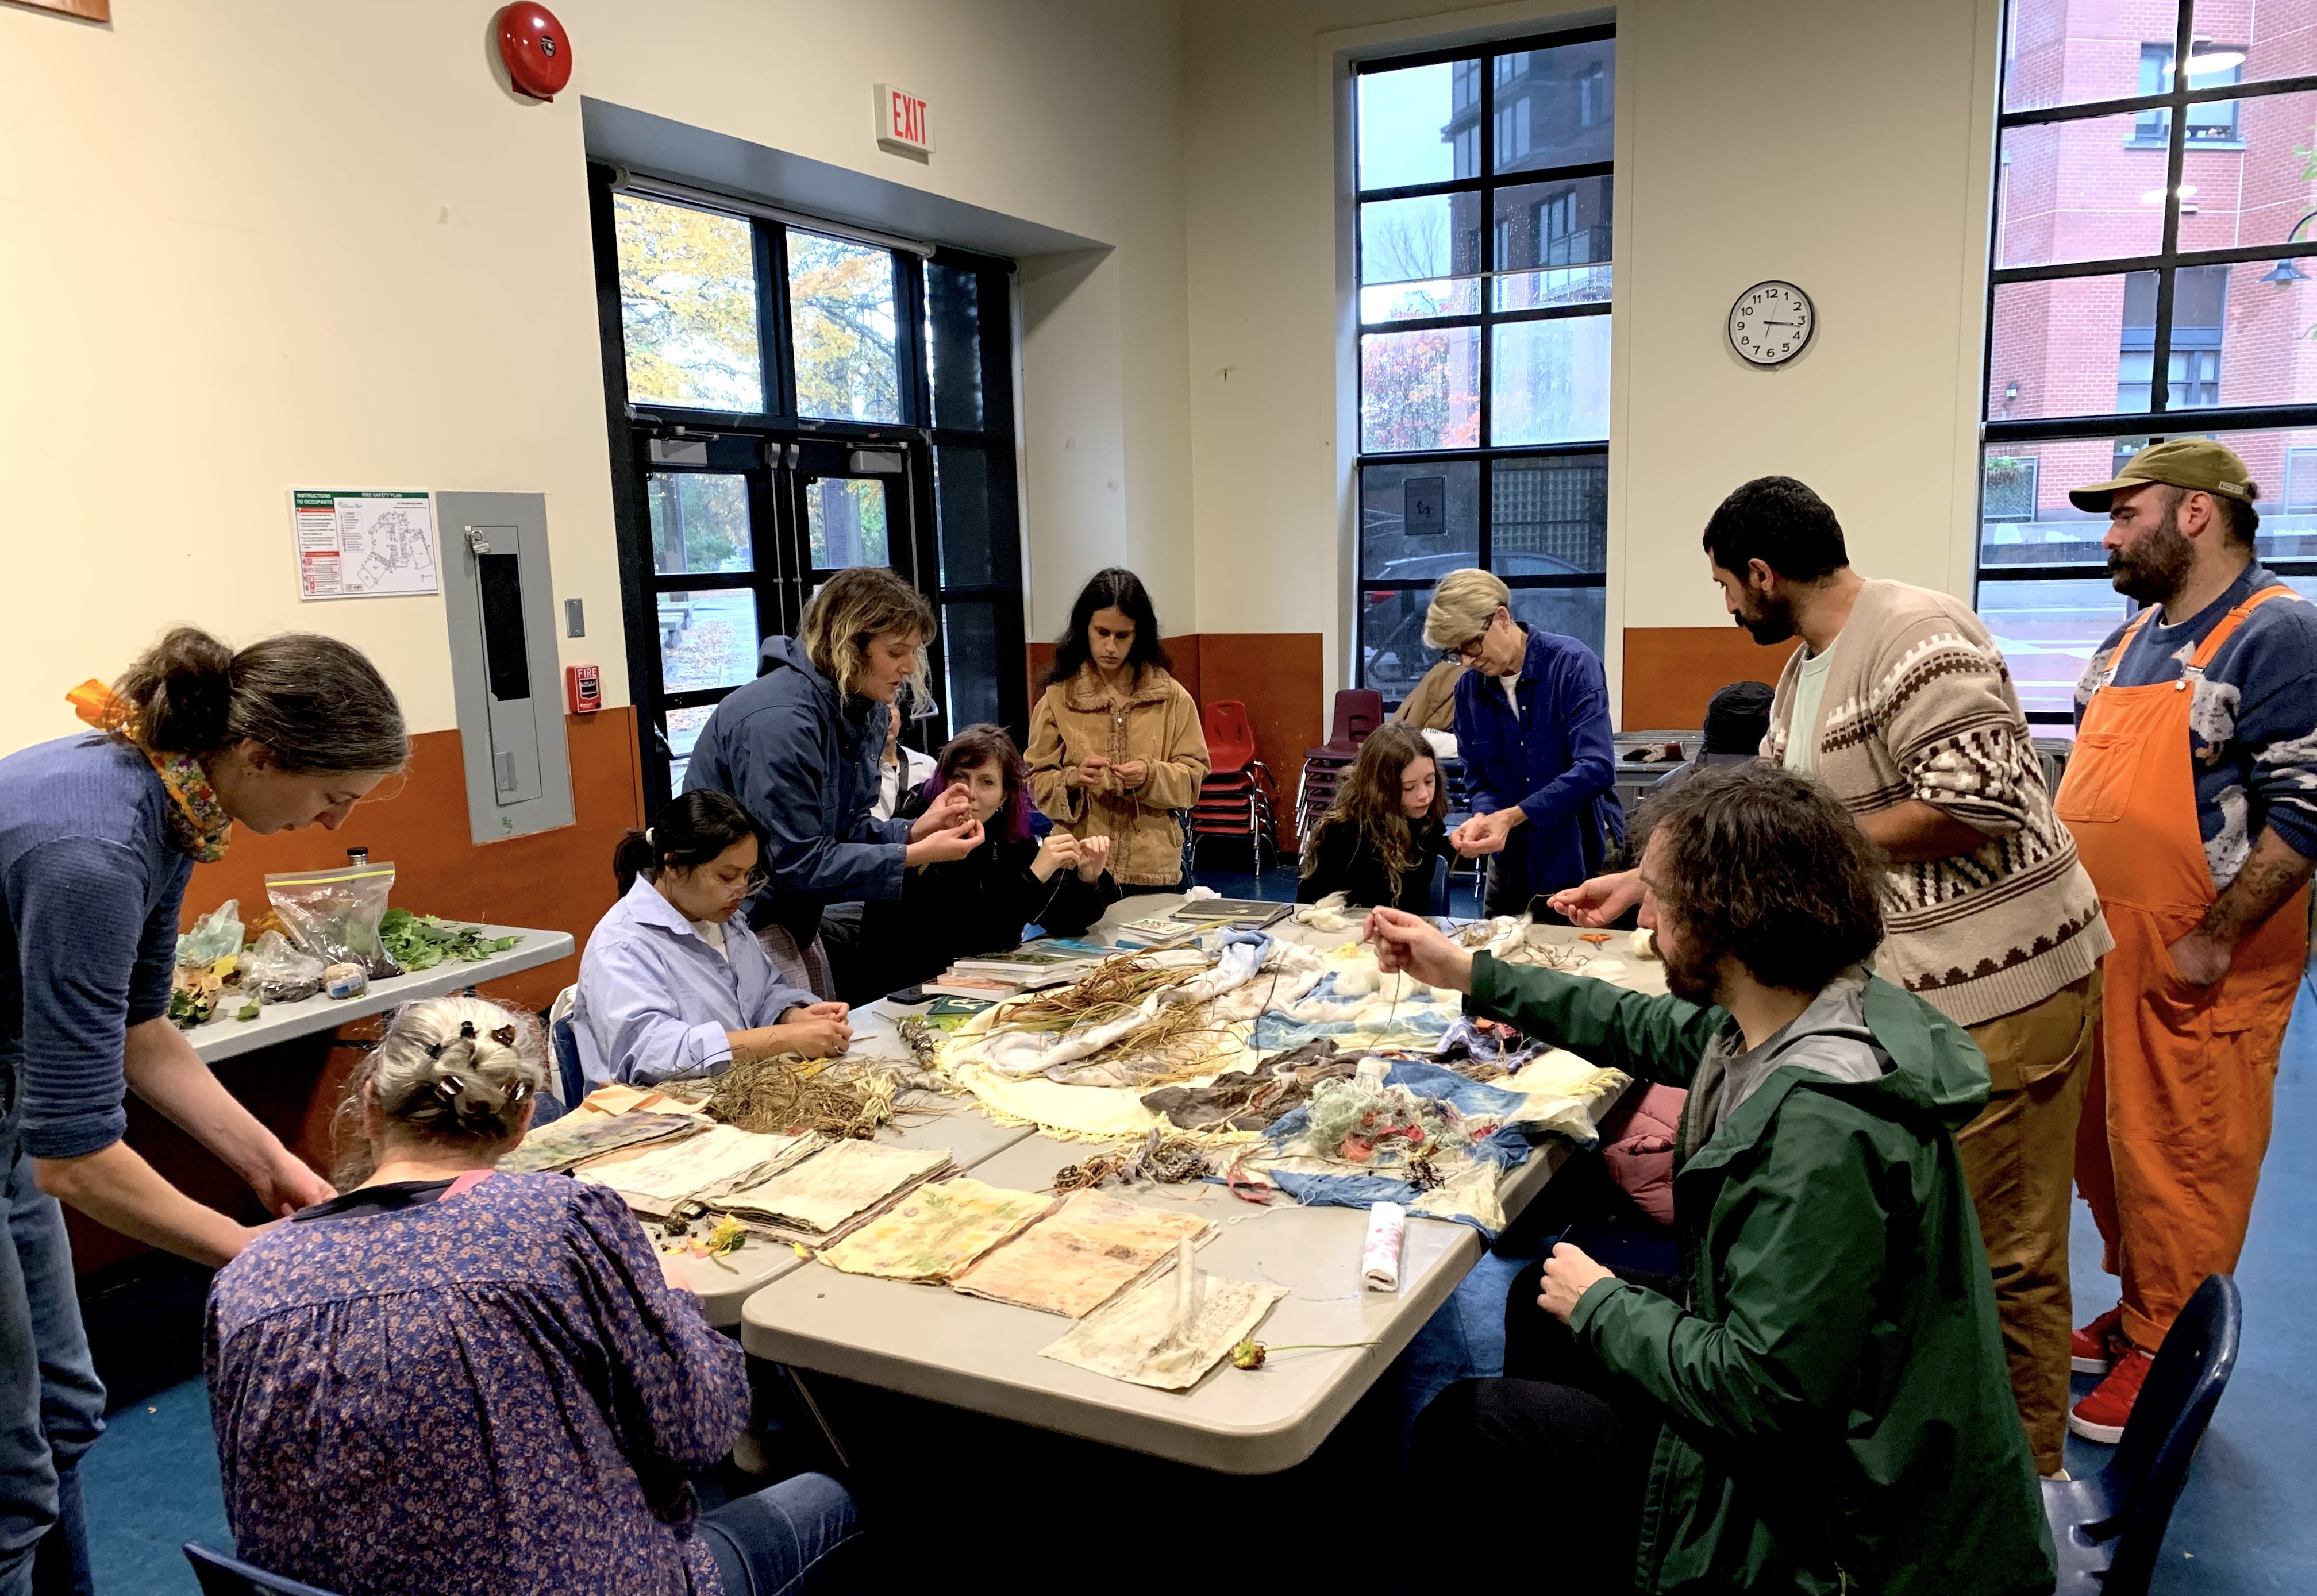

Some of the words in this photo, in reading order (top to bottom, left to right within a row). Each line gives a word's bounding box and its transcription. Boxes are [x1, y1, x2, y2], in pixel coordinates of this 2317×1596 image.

[892, 91, 926, 145] EXIT
[1765, 289, 1778, 298] 12
[1784, 292, 1788, 301] 1
[1753, 294, 1761, 304] 11
[1793, 302, 1802, 311] 2
[1741, 307, 1753, 316] 10
[1798, 316, 1806, 325] 3
[1737, 322, 1745, 330] 9
[1792, 331, 1800, 340] 4
[1741, 336, 1749, 345] 8
[1753, 345, 1761, 354] 7
[1782, 342, 1790, 352] 5
[1766, 349, 1775, 357] 6
[578, 668, 597, 678] FIRE
